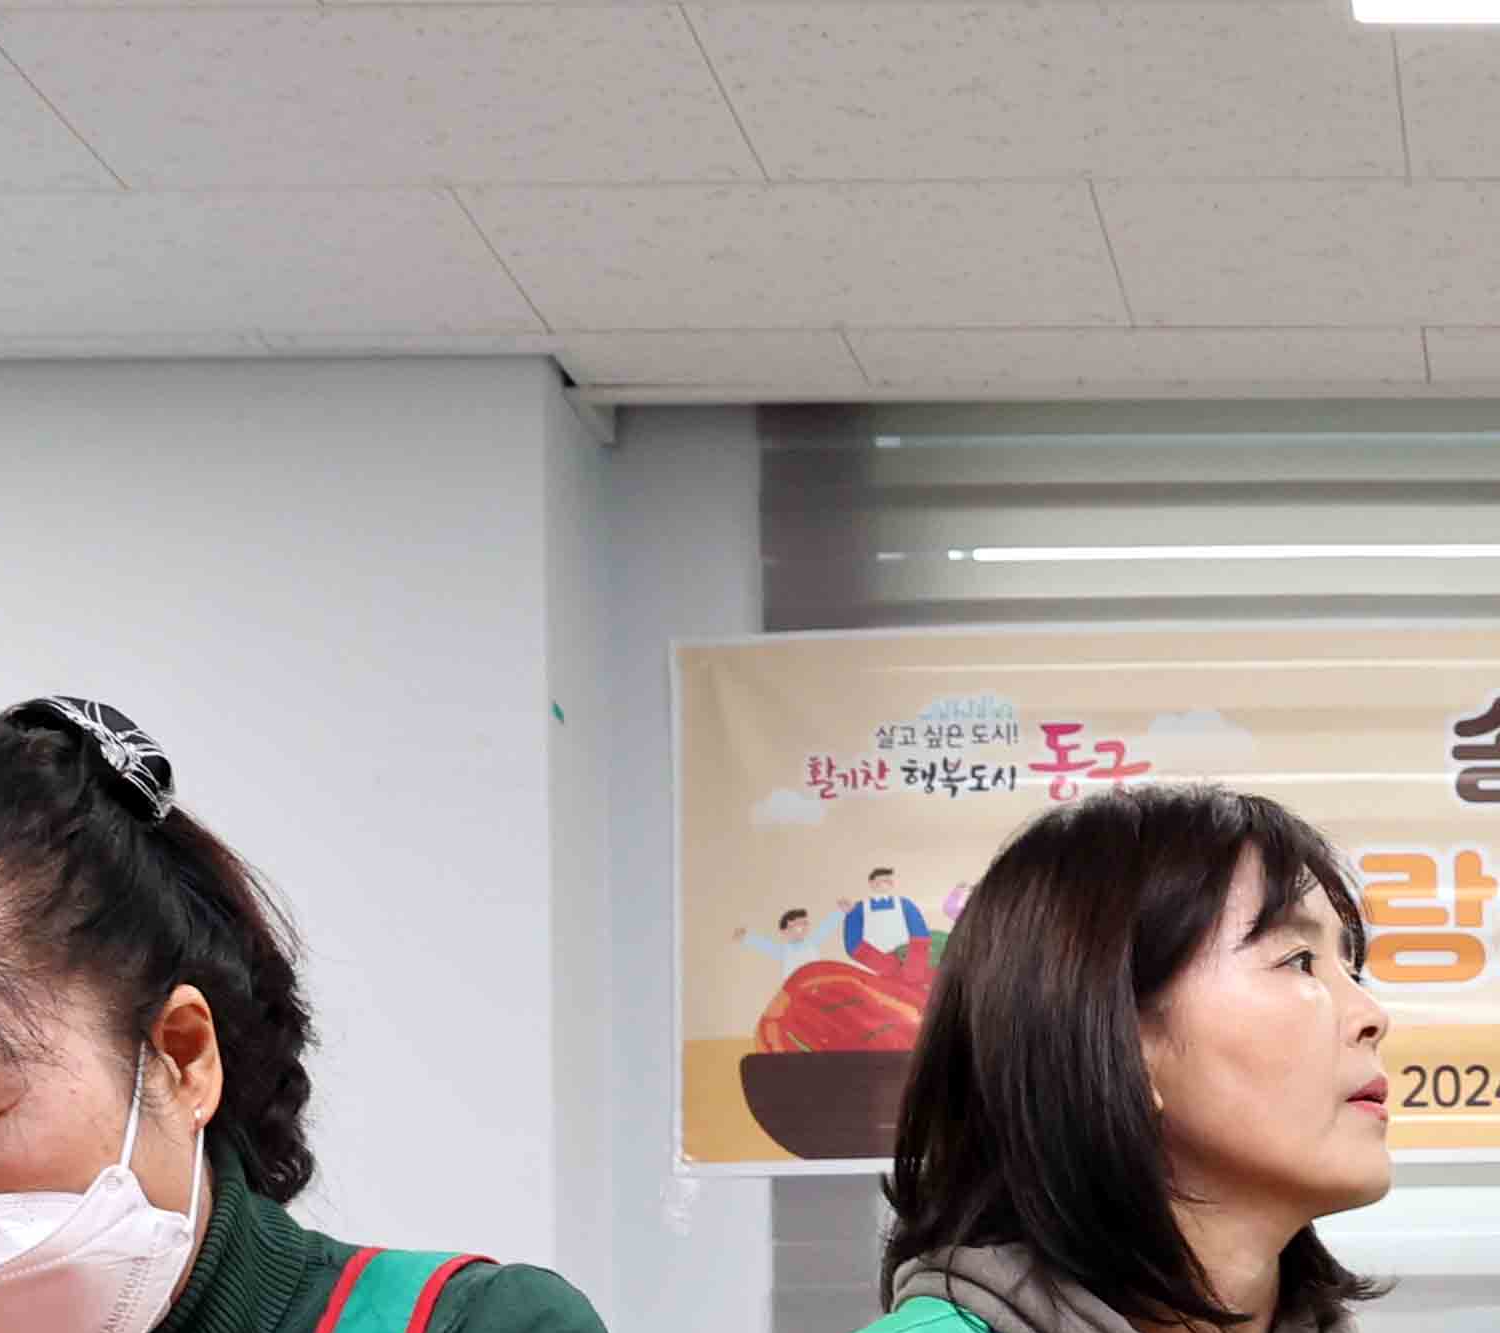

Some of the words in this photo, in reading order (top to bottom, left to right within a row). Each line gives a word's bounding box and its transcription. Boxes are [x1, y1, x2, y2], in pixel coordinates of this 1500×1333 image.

[875, 722, 917, 750] 살고
[923, 722, 965, 750] 싶은
[971, 721, 1019, 746] 도시!
[805, 756, 891, 800] 활기찬
[900, 756, 1018, 798] 행복도시
[1028, 722, 1152, 802] 동구
